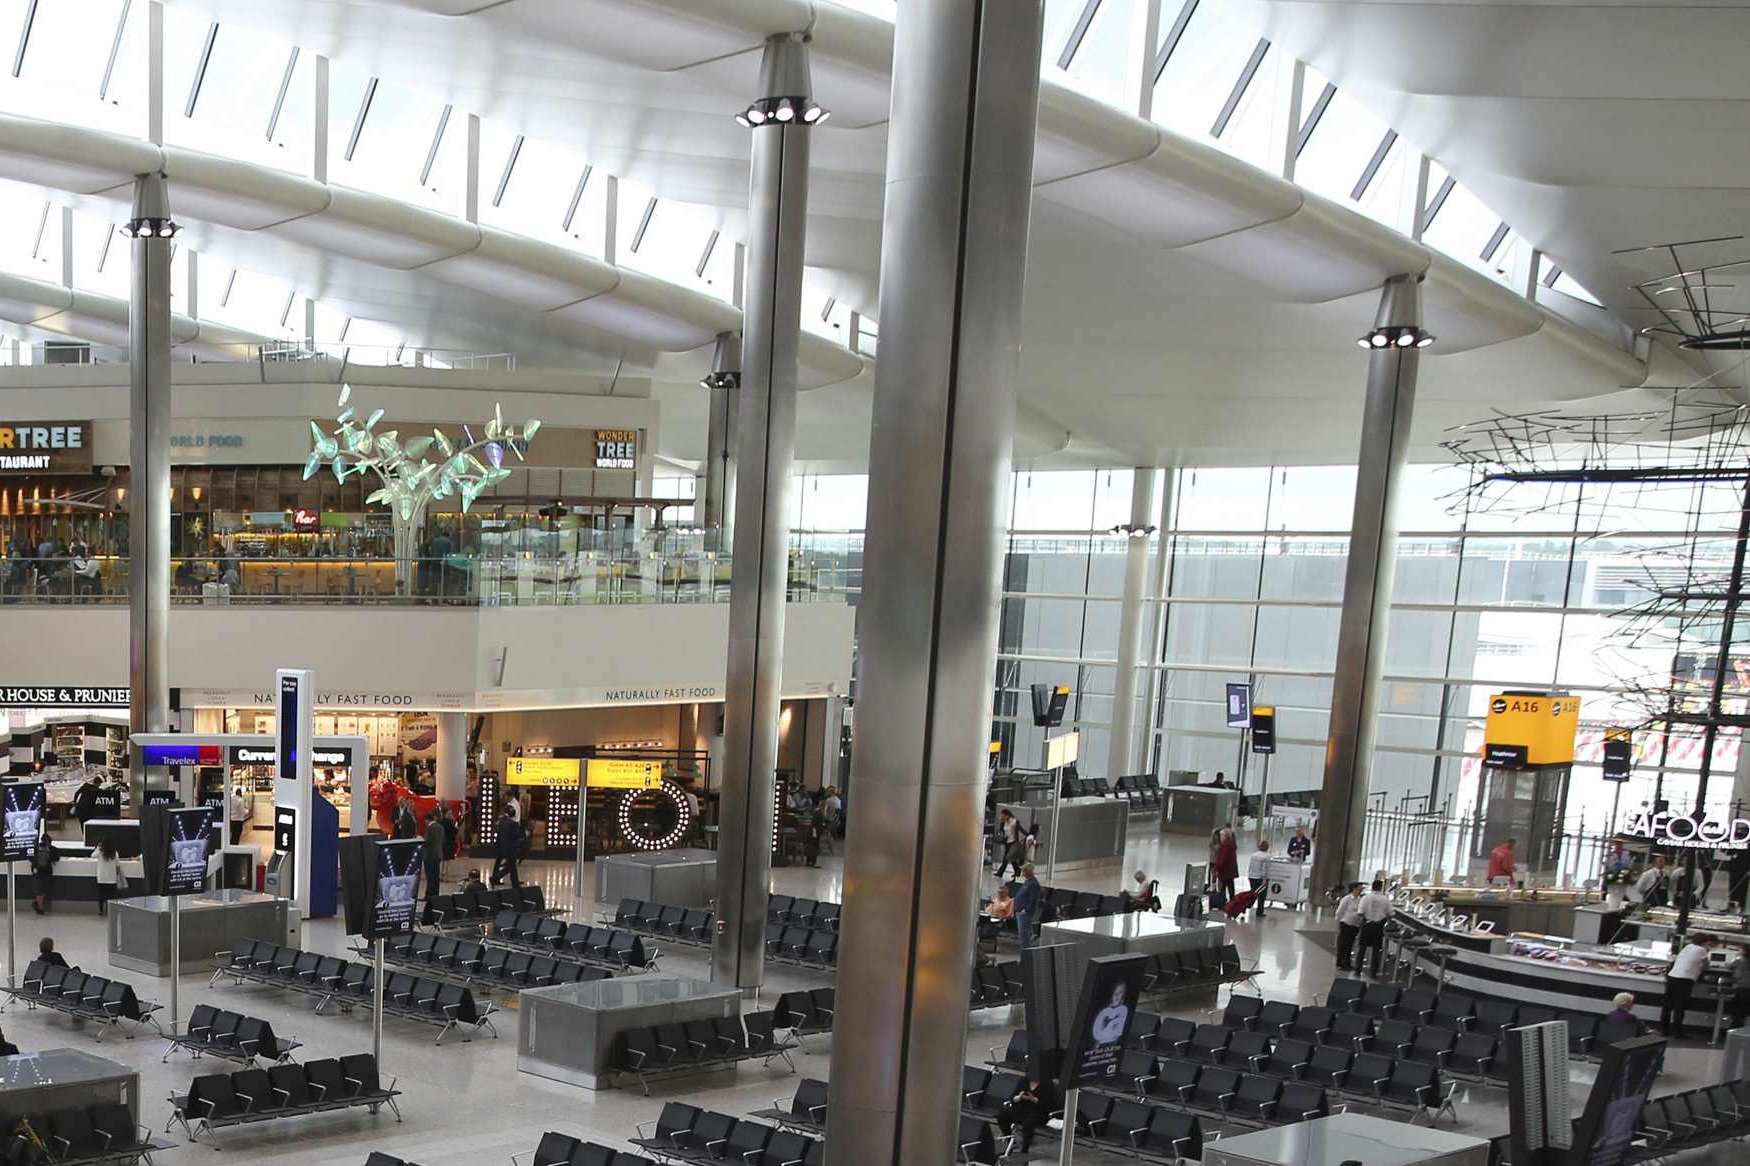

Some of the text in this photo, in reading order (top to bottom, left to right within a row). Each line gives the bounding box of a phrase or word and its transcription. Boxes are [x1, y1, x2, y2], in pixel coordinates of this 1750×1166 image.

[170, 435, 203, 448] ORLD
[597, 431, 635, 441] WONDER
[596, 442, 634, 458] TREE
[596, 458, 634, 469] WORLD FOOD
[7, 688, 56, 702] HOUSE
[58, 689, 72, 702] &
[606, 687, 715, 700] NATURALLY FAST FOOD
[337, 694, 367, 705] FAST
[373, 695, 412, 705] FOOD
[1511, 701, 1539, 713] A16
[162, 756, 196, 765] Travelex
[238, 749, 345, 764] Curren hange
[95, 796, 114, 806] ATM
[150, 797, 169, 805] ATM
[205, 798, 224, 807] ATM
